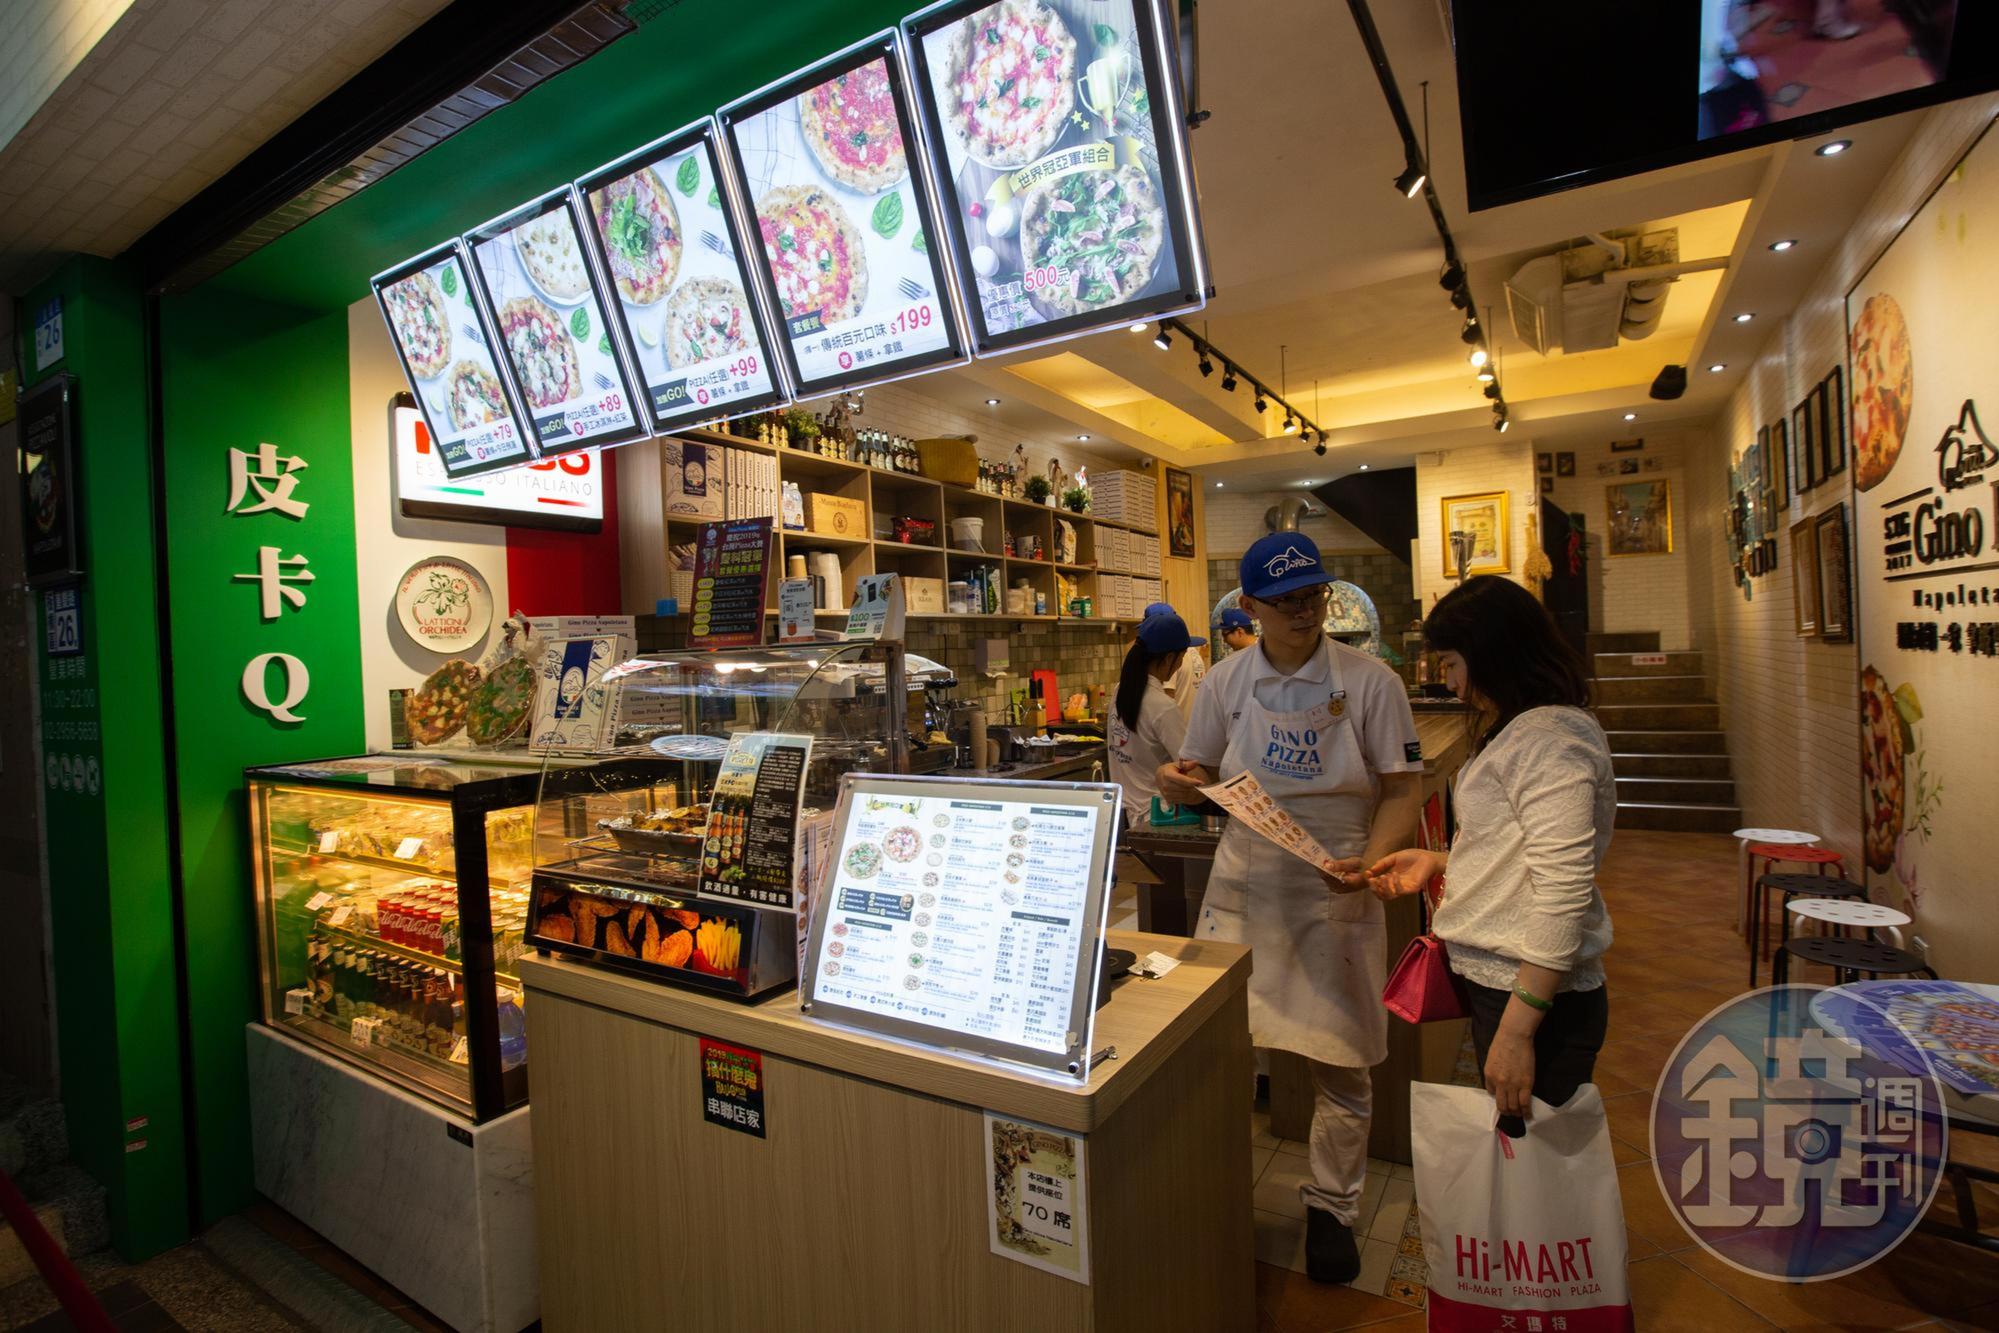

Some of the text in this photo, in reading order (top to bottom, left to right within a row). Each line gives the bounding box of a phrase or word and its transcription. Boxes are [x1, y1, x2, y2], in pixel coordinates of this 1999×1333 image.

[1017, 147, 1111, 189] 世界冠亞軍組合
[1023, 265, 1071, 293] 500元
[821, 324, 888, 352] 傳統百元口味
[890, 305, 932, 336] $199
[728, 355, 759, 378] +99
[598, 393, 622, 413] +89
[493, 424, 513, 441] +79
[516, 474, 593, 498] ITALIANO
[1913, 496, 1984, 565] Gino
[419, 625, 468, 635] ORCHIDEA
[1270, 724, 1318, 747] GINO
[1266, 742, 1321, 766] PIZZA
[704, 880, 788, 905] 飲酒過量 有害健康
[707, 1097, 761, 1129] 串聯店家
[1027, 1170, 1063, 1189] 本店樓上
[1028, 1184, 1063, 1201] 提供座位
[1022, 1201, 1072, 1230] 70 席
[1456, 1234, 1594, 1284] Hi-MART
[1457, 1282, 1603, 1299] Hi-MART FASHION PLAZA
